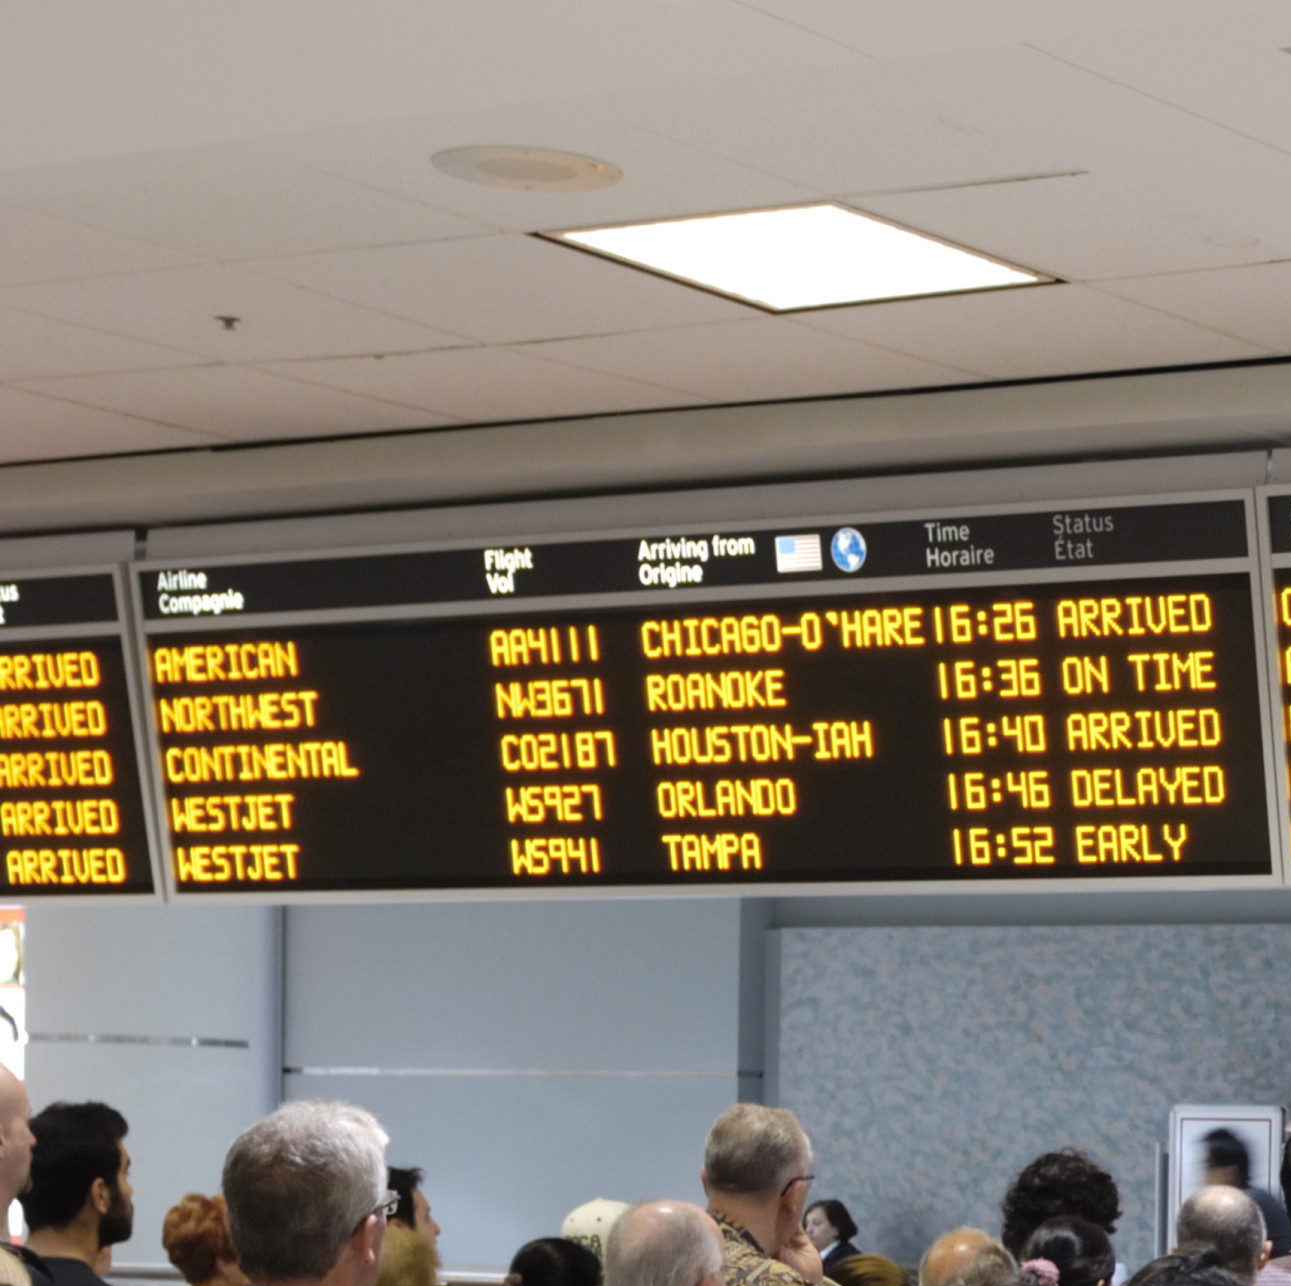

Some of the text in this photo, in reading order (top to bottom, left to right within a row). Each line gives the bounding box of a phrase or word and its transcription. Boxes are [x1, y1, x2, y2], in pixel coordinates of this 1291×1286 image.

[925, 523, 969, 542] Time
[1053, 514, 1113, 535] Status
[485, 548, 533, 571] Flight
[638, 535, 755, 562] Arriving from
[926, 548, 994, 567] Horaire
[1055, 537, 1094, 560] État
[158, 571, 207, 590] Airline
[487, 572, 514, 593] Vol
[639, 562, 703, 588] Origine
[159, 589, 244, 615] Compagnie
[1057, 594, 1212, 637] ARRIVED
[642, 607, 924, 658] CHICAGO-O'HARE
[934, 602, 1036, 643] 16:26
[155, 642, 297, 682] AMERICAN
[490, 626, 598, 666] AA4111
[647, 669, 786, 711] ROANOKE
[939, 659, 1040, 699] 16:36
[1062, 651, 1216, 694] ON TIME
[160, 691, 317, 732] NORTHWEST
[496, 678, 603, 718] NW3671
[0, 701, 106, 738] RRIVED
[944, 715, 1045, 754] 16:40
[1067, 709, 1220, 750] ARRIVED
[501, 731, 615, 771] CO2187
[652, 721, 872, 764] HOUSTON-IAH
[166, 742, 358, 782] CONTINENTAL
[506, 784, 601, 822] WS927
[657, 778, 796, 817] ORLANDO
[949, 771, 1050, 810] 16:46
[1071, 766, 1224, 807] DELAYED
[0, 799, 118, 835] ARRIVED
[172, 794, 293, 832] WESTJET
[177, 844, 298, 881] WESTJET
[511, 838, 599, 874] WS941
[662, 833, 761, 870] TAMPA
[953, 827, 1054, 864] 16:52
[1076, 824, 1186, 863] EARLY
[7, 848, 125, 883] ARRIVED
